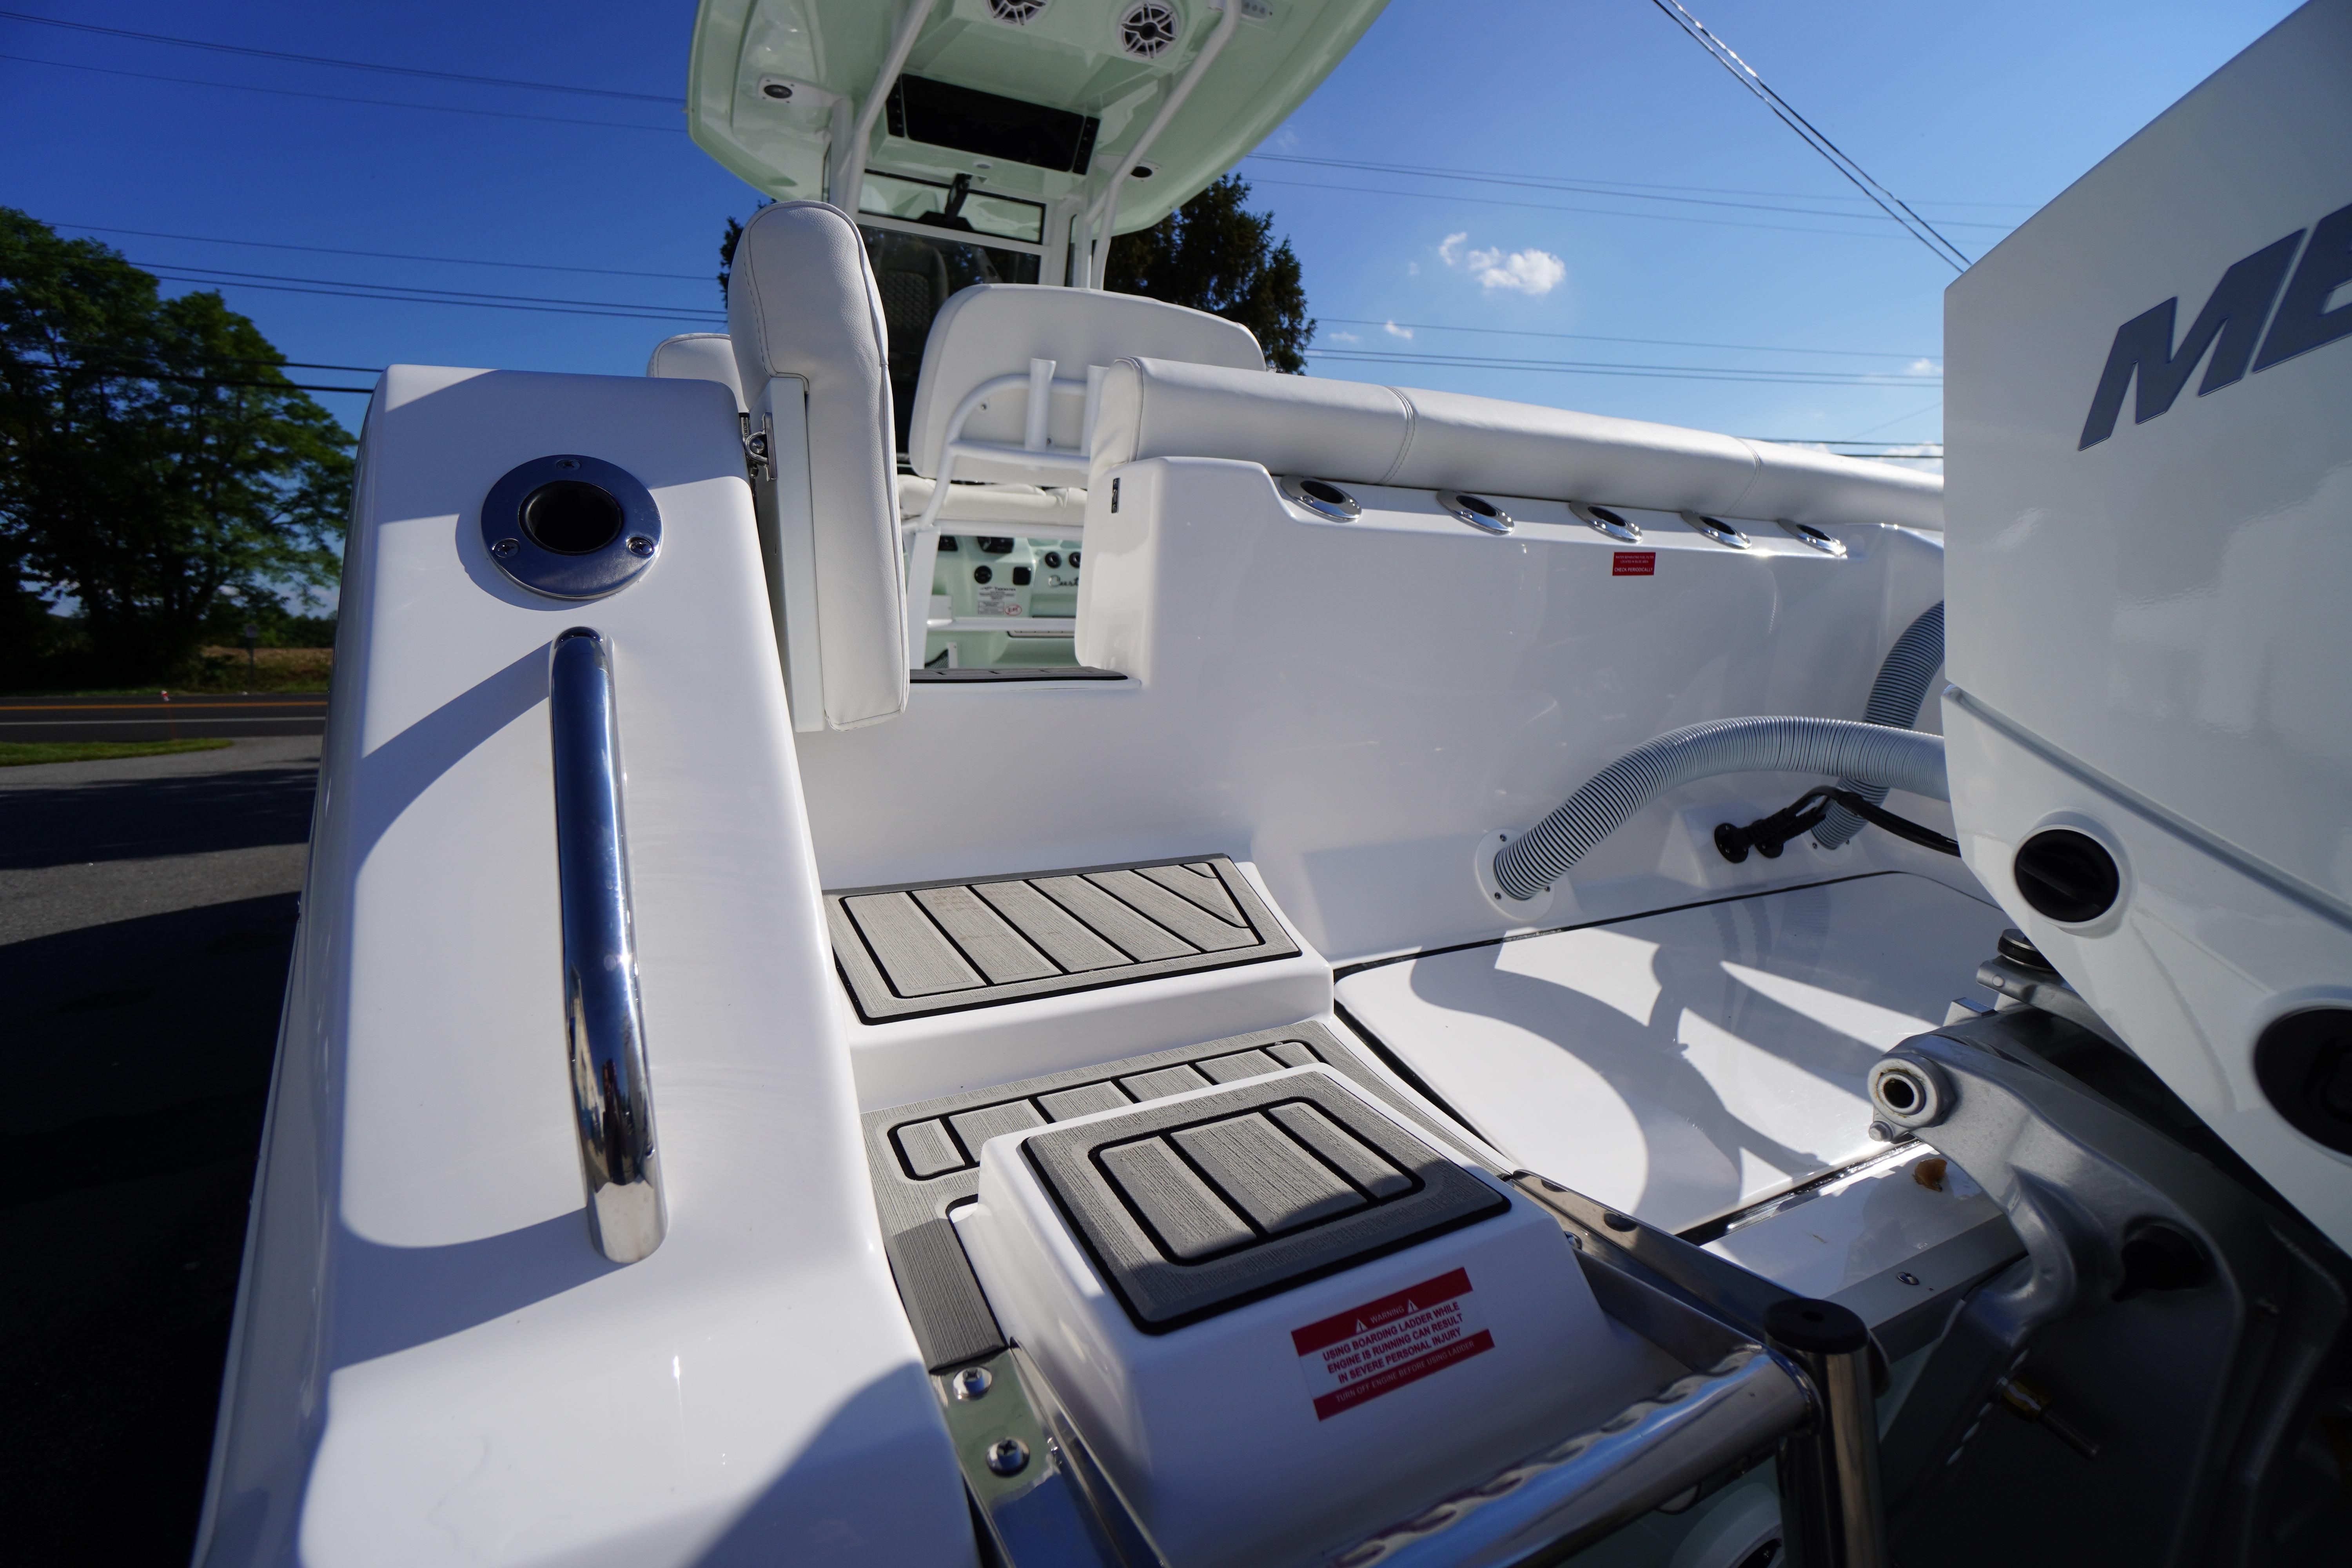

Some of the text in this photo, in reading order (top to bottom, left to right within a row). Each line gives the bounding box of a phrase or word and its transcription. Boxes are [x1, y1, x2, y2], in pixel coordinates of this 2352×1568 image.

[1323, 1301, 1460, 1361] USING BOARDING LADDER WHILE
[1327, 1313, 1463, 1374] ENGINE IS RUNNING CAN RESULT
[1370, 1306, 1405, 1324] WARNING
[1336, 1341, 1475, 1402] TURN OFF ENGINE BEFORE USING LADDER
[1338, 1327, 1461, 1384] IN SEVERE PERSONAL INJURY
